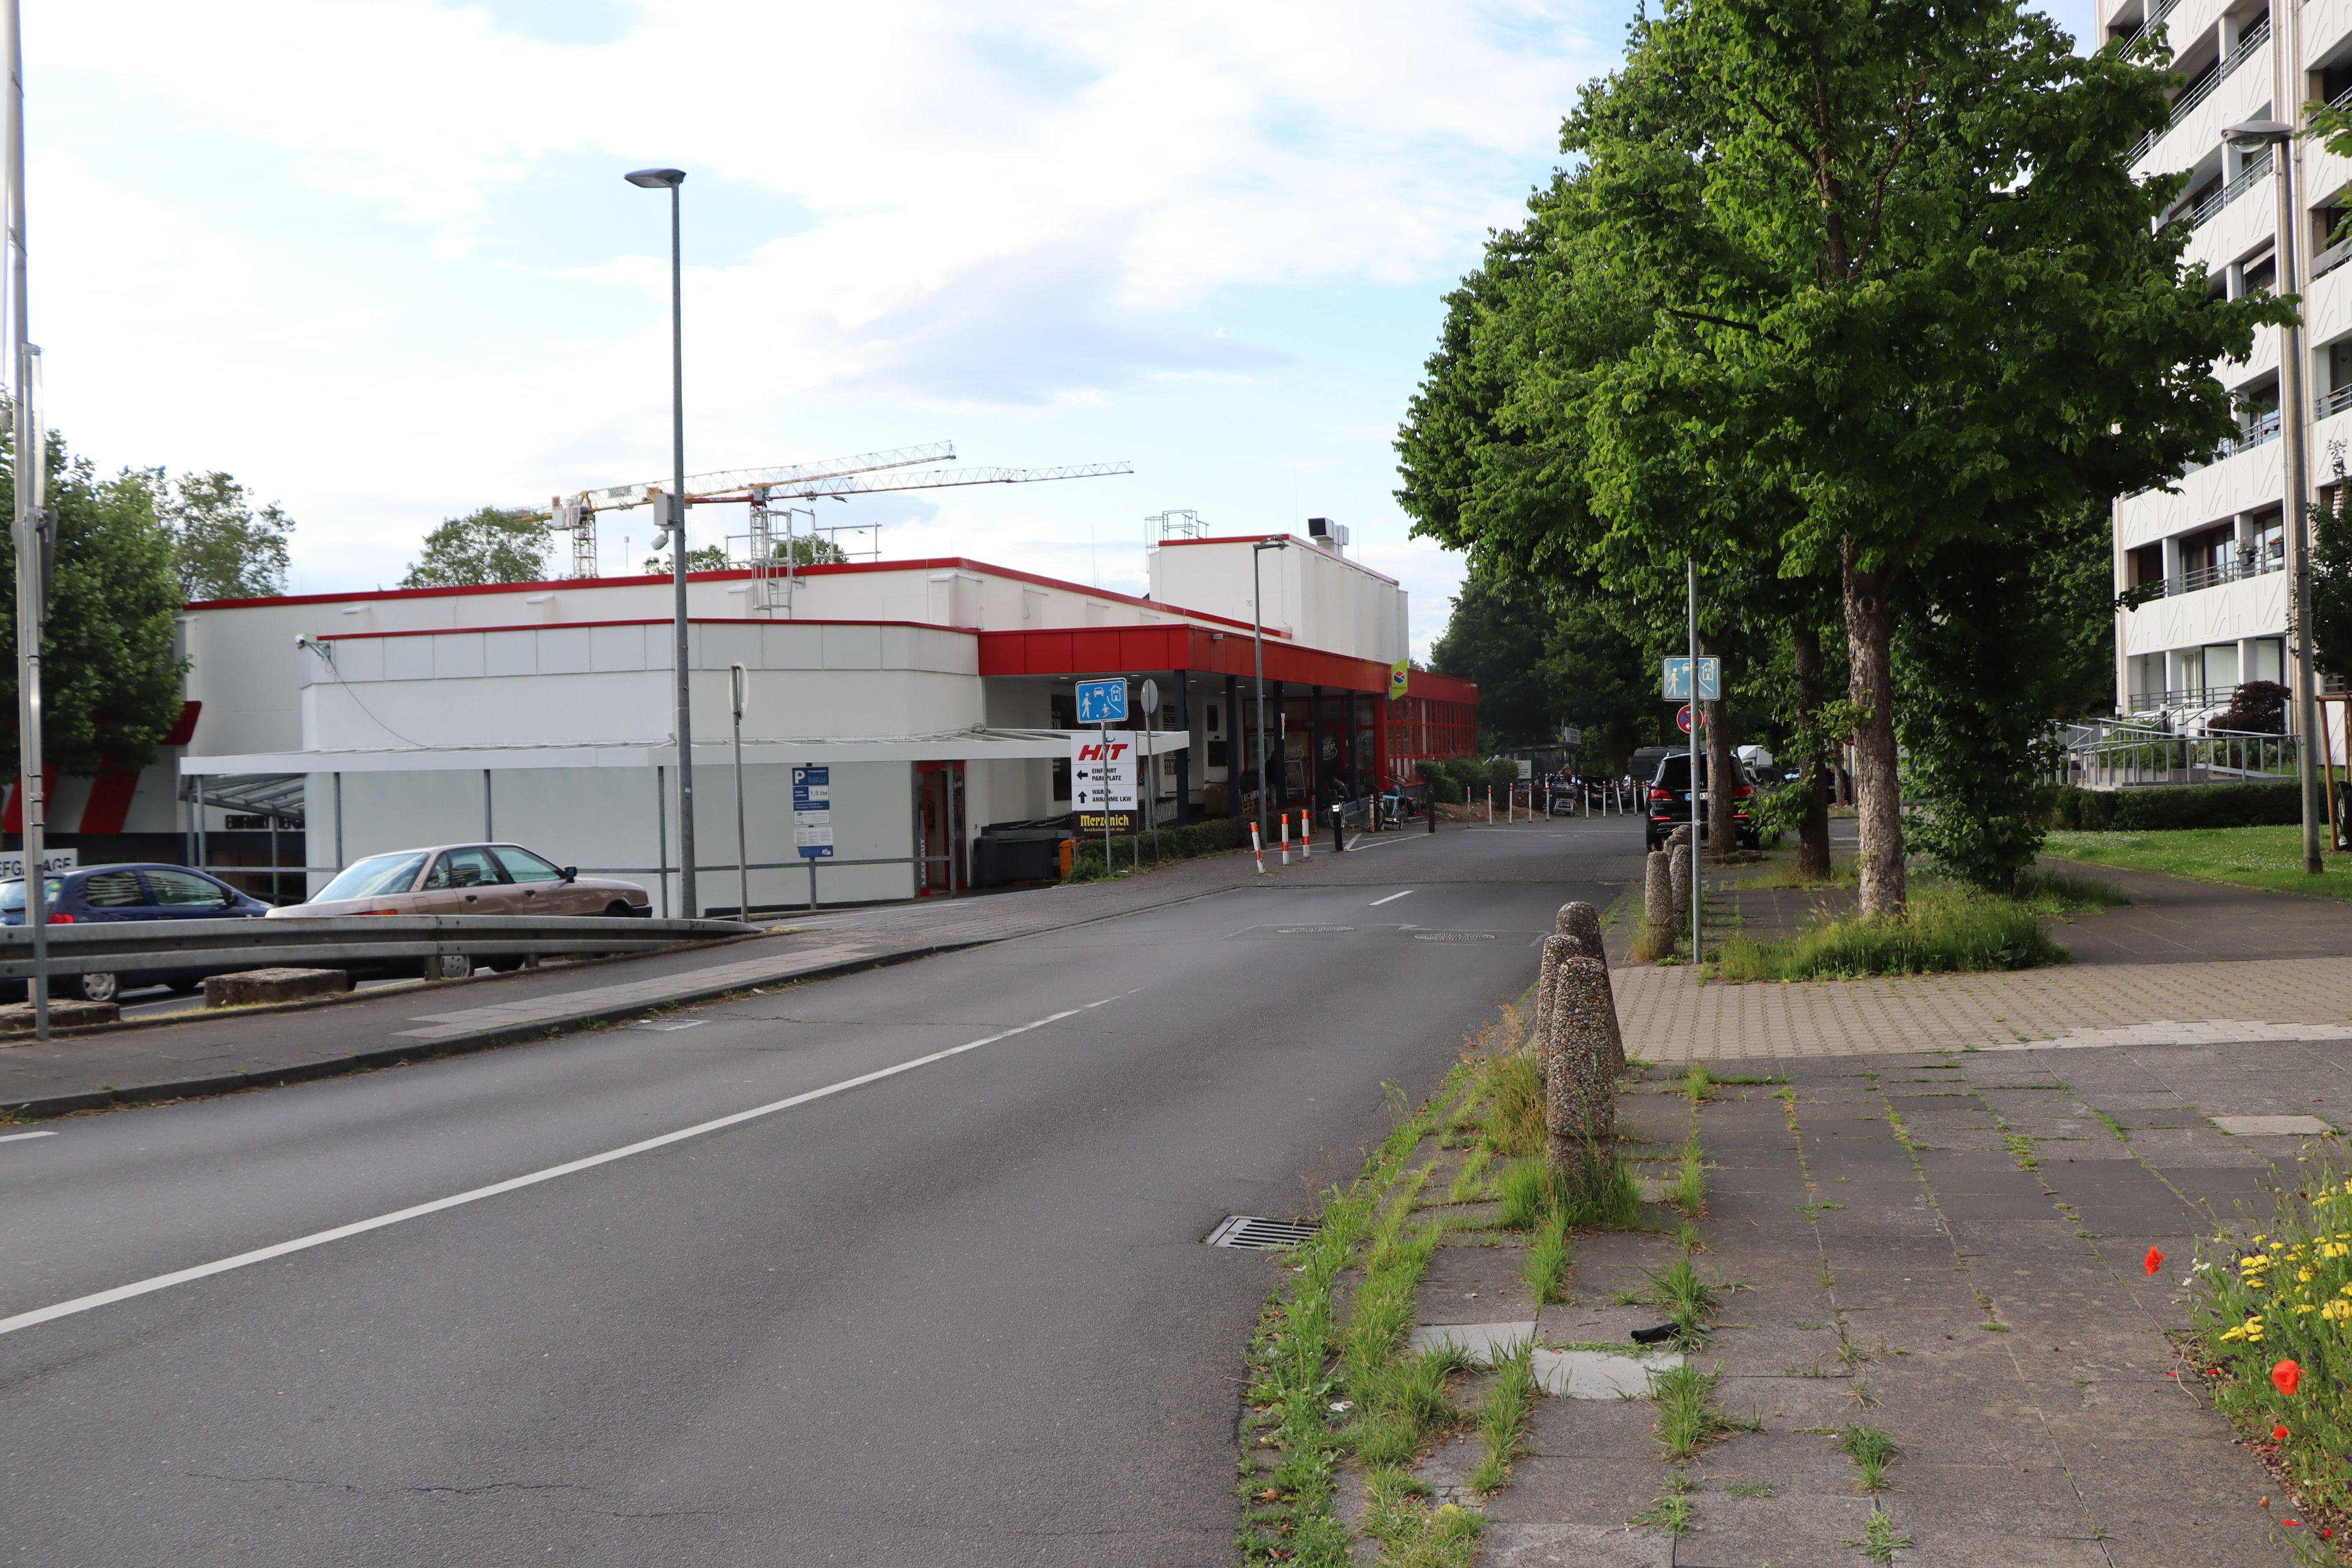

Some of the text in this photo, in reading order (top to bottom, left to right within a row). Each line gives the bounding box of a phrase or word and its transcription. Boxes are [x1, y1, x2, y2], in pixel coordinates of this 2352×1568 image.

[795, 770, 805, 783] P
[1080, 815, 1129, 827] Merznich
[0, 858, 71, 876] FGAGE
